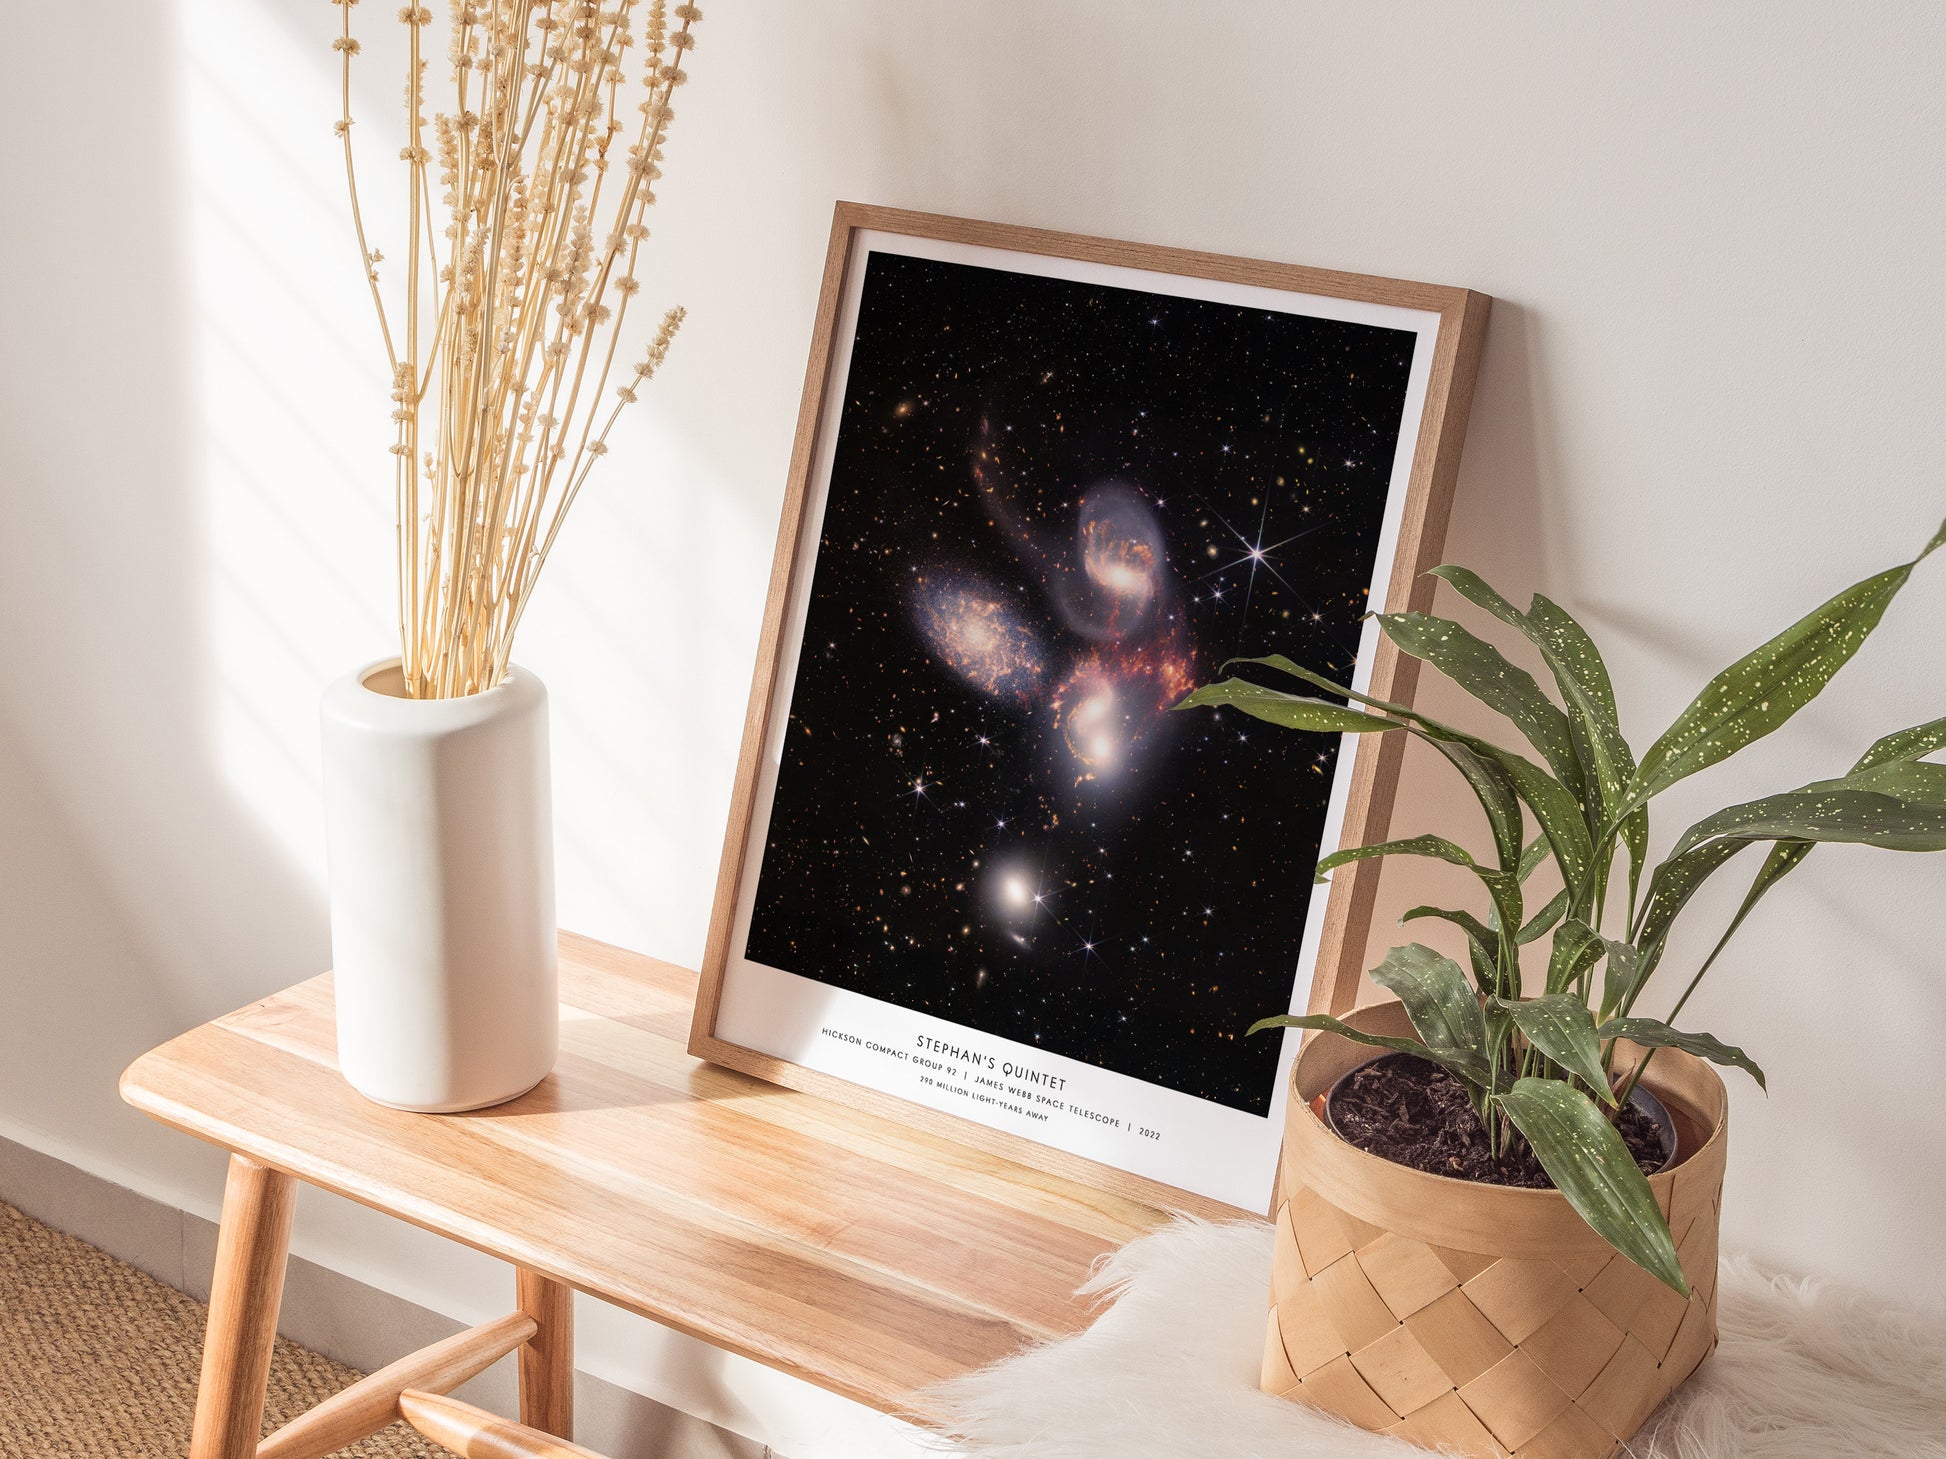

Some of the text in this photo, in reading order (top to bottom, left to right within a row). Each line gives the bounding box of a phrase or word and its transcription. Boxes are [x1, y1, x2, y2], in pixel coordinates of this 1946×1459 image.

[821, 1027, 862, 1046] HICKSON
[865, 1041, 909, 1061] COMPACT
[912, 1055, 943, 1071] GROUP
[946, 1066, 957, 1076] 92
[974, 1075, 1004, 1091] JAMES
[1008, 1085, 1032, 1100] WEBB
[1035, 1094, 1065, 1111] SPACE
[1069, 1104, 1120, 1128] TELESCOPE
[1138, 1127, 1161, 1141] 2022
[916, 1034, 1067, 1091] STEPHAN'S QUINTET
[919, 1075, 1049, 1122] 290 MILLION LIGHT-YEARS AWAY
